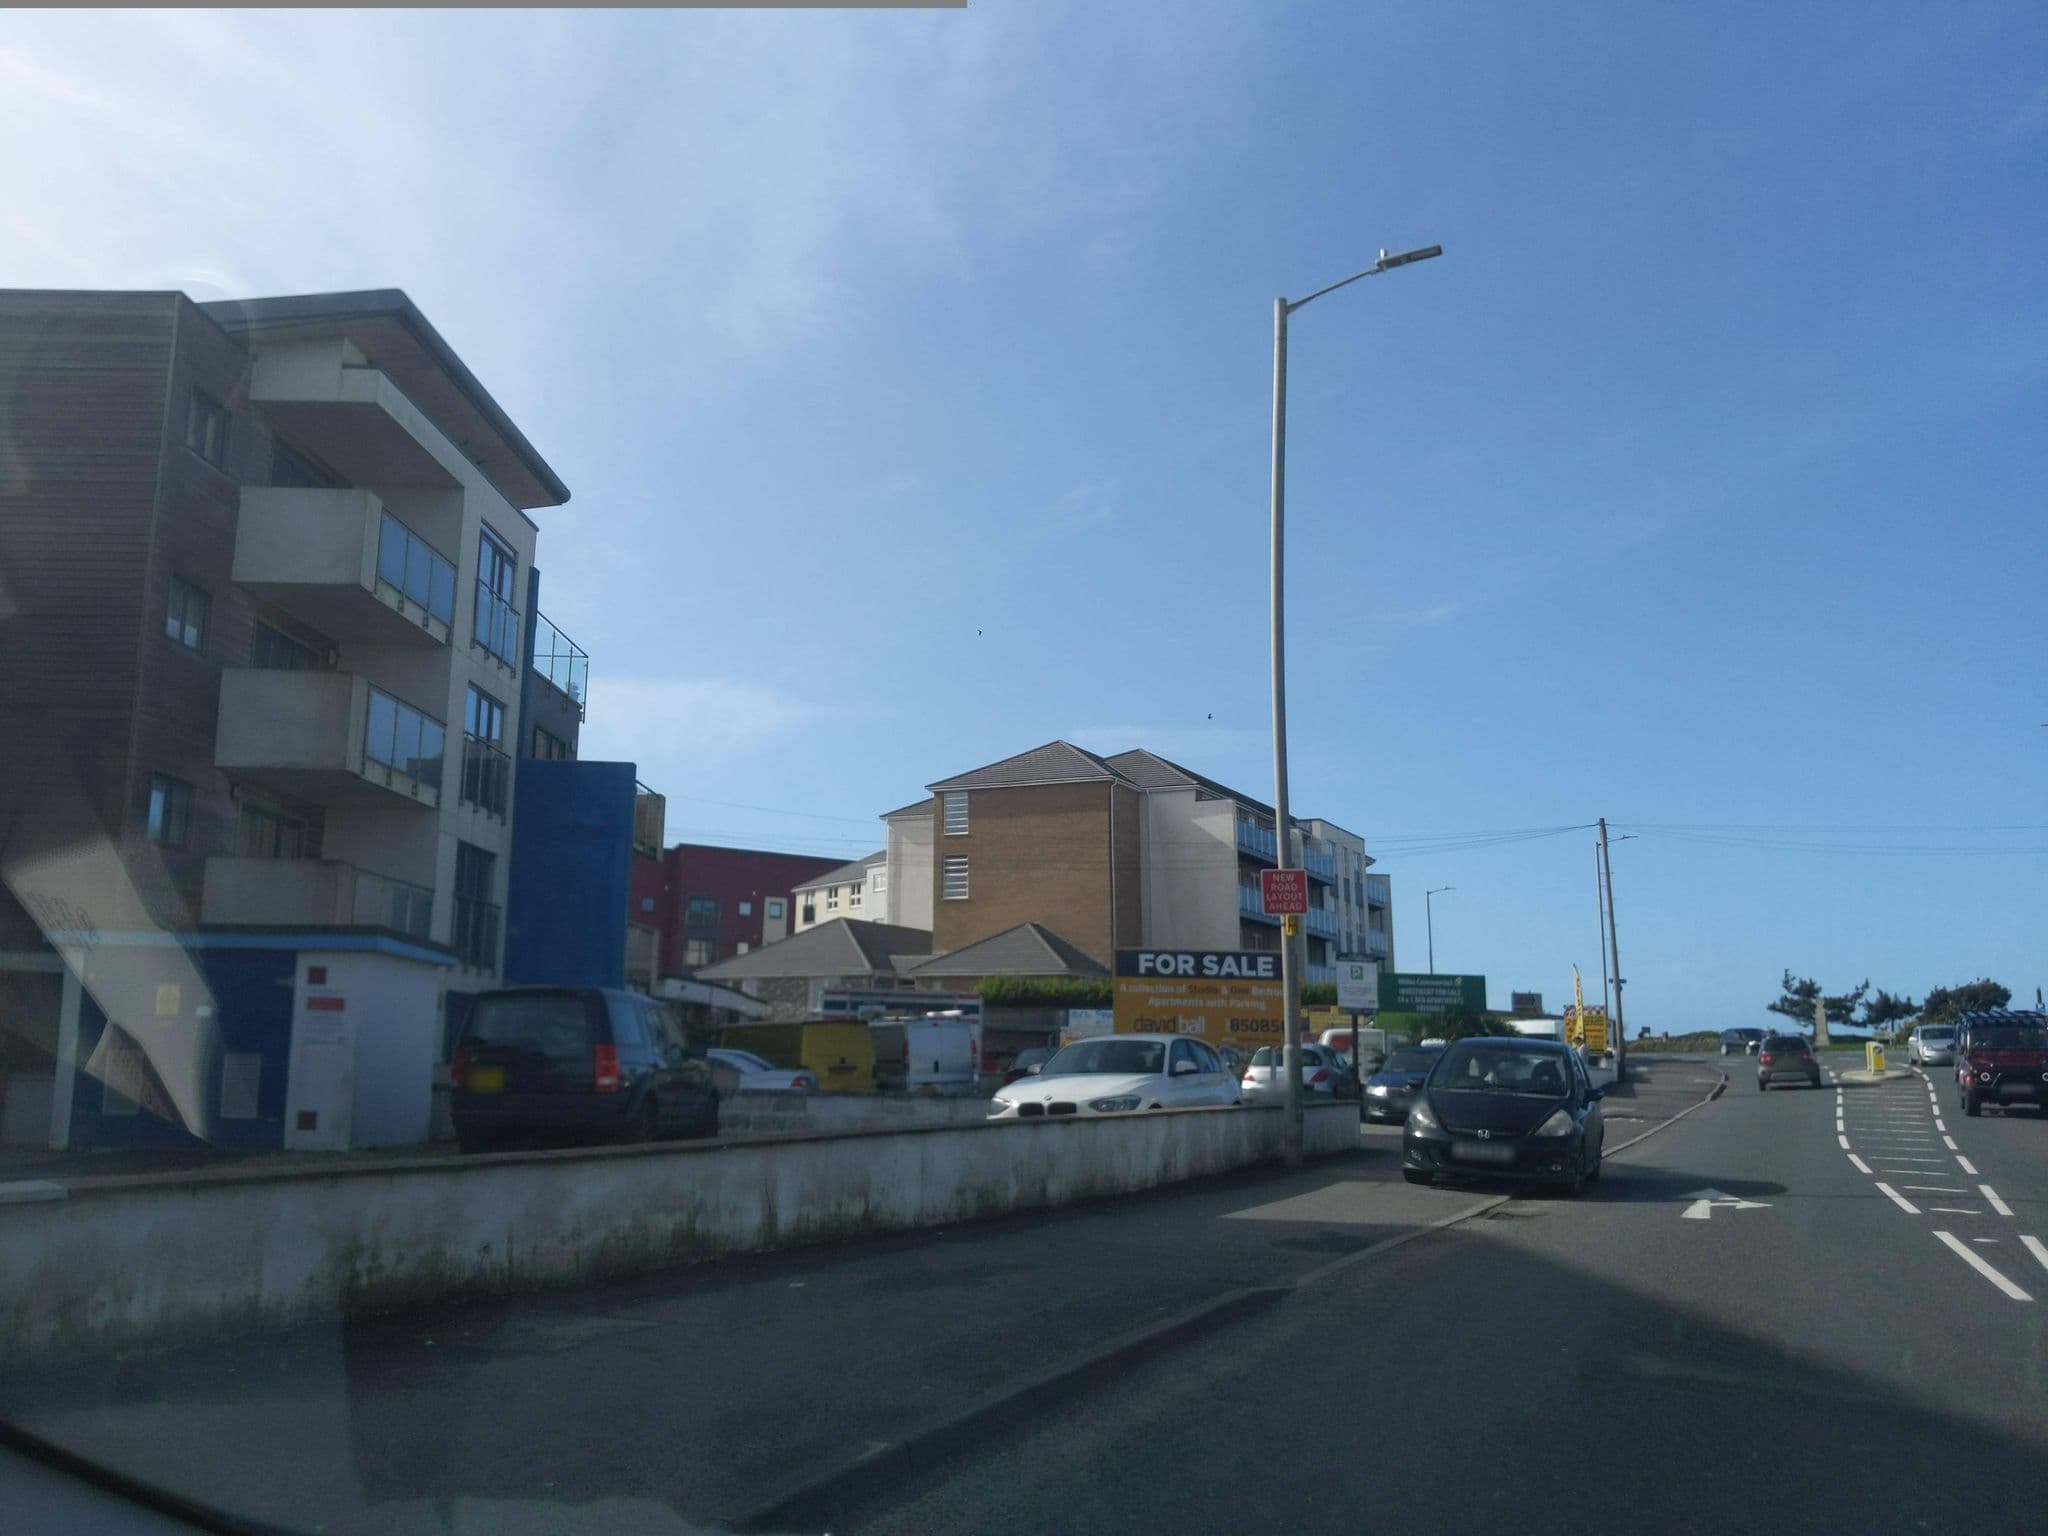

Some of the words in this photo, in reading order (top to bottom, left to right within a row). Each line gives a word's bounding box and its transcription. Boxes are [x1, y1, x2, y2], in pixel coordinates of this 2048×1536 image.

[1272, 873, 1296, 881] NEW
[1271, 883, 1298, 892] ROAD
[1266, 892, 1303, 902] LAYOUT
[1269, 902, 1303, 911] AHEAD
[1138, 953, 1195, 975] FOR
[1202, 955, 1274, 977] SALE
[1129, 983, 1174, 994] collection
[1147, 996, 1204, 1009] Apartments
[1229, 999, 1265, 1011] Parking
[1132, 1015, 1176, 1033] david
